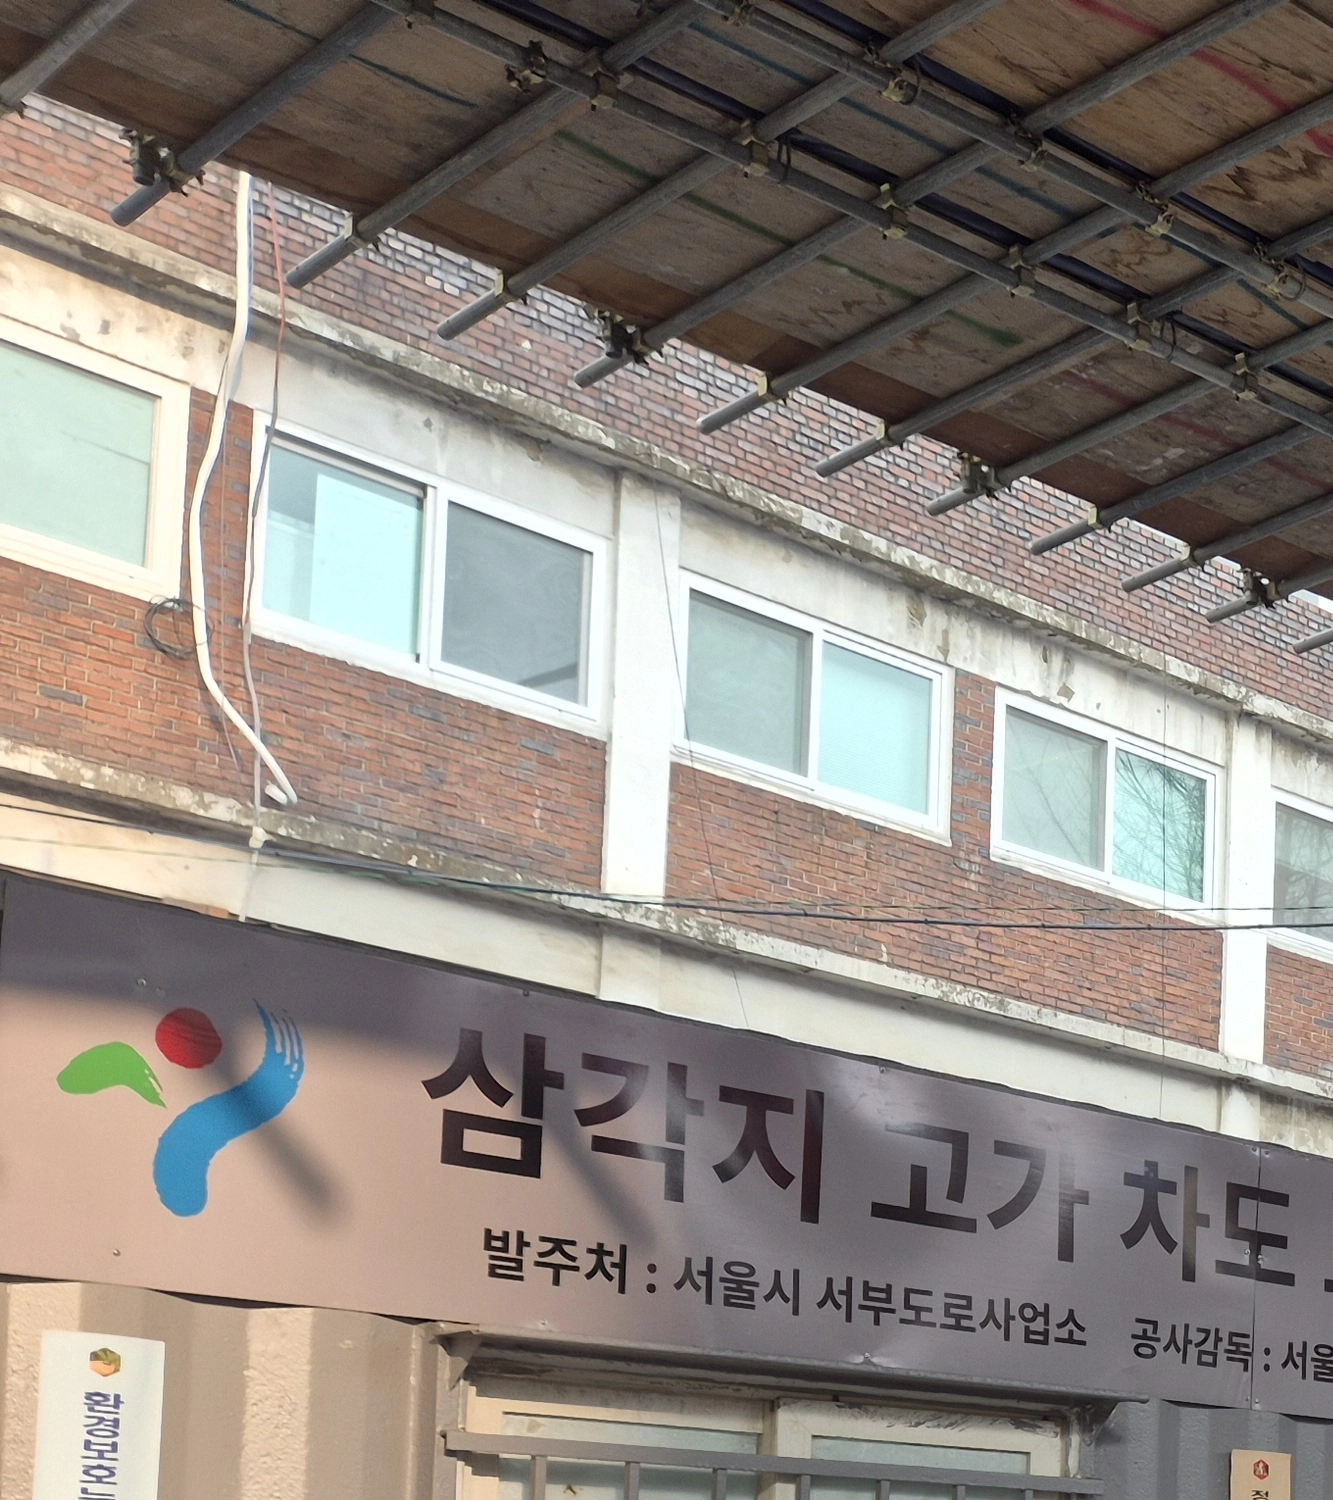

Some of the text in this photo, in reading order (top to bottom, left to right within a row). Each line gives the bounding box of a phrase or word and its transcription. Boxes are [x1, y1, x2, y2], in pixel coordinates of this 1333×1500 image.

[421, 1027, 825, 1224] 삼각지
[870, 1121, 1090, 1264] 고가
[1119, 1159, 1296, 1287] 차도
[483, 1227, 628, 1295] 발주처
[673, 1255, 801, 1316] 서울시
[816, 1274, 1087, 1347] 서부도로사업소
